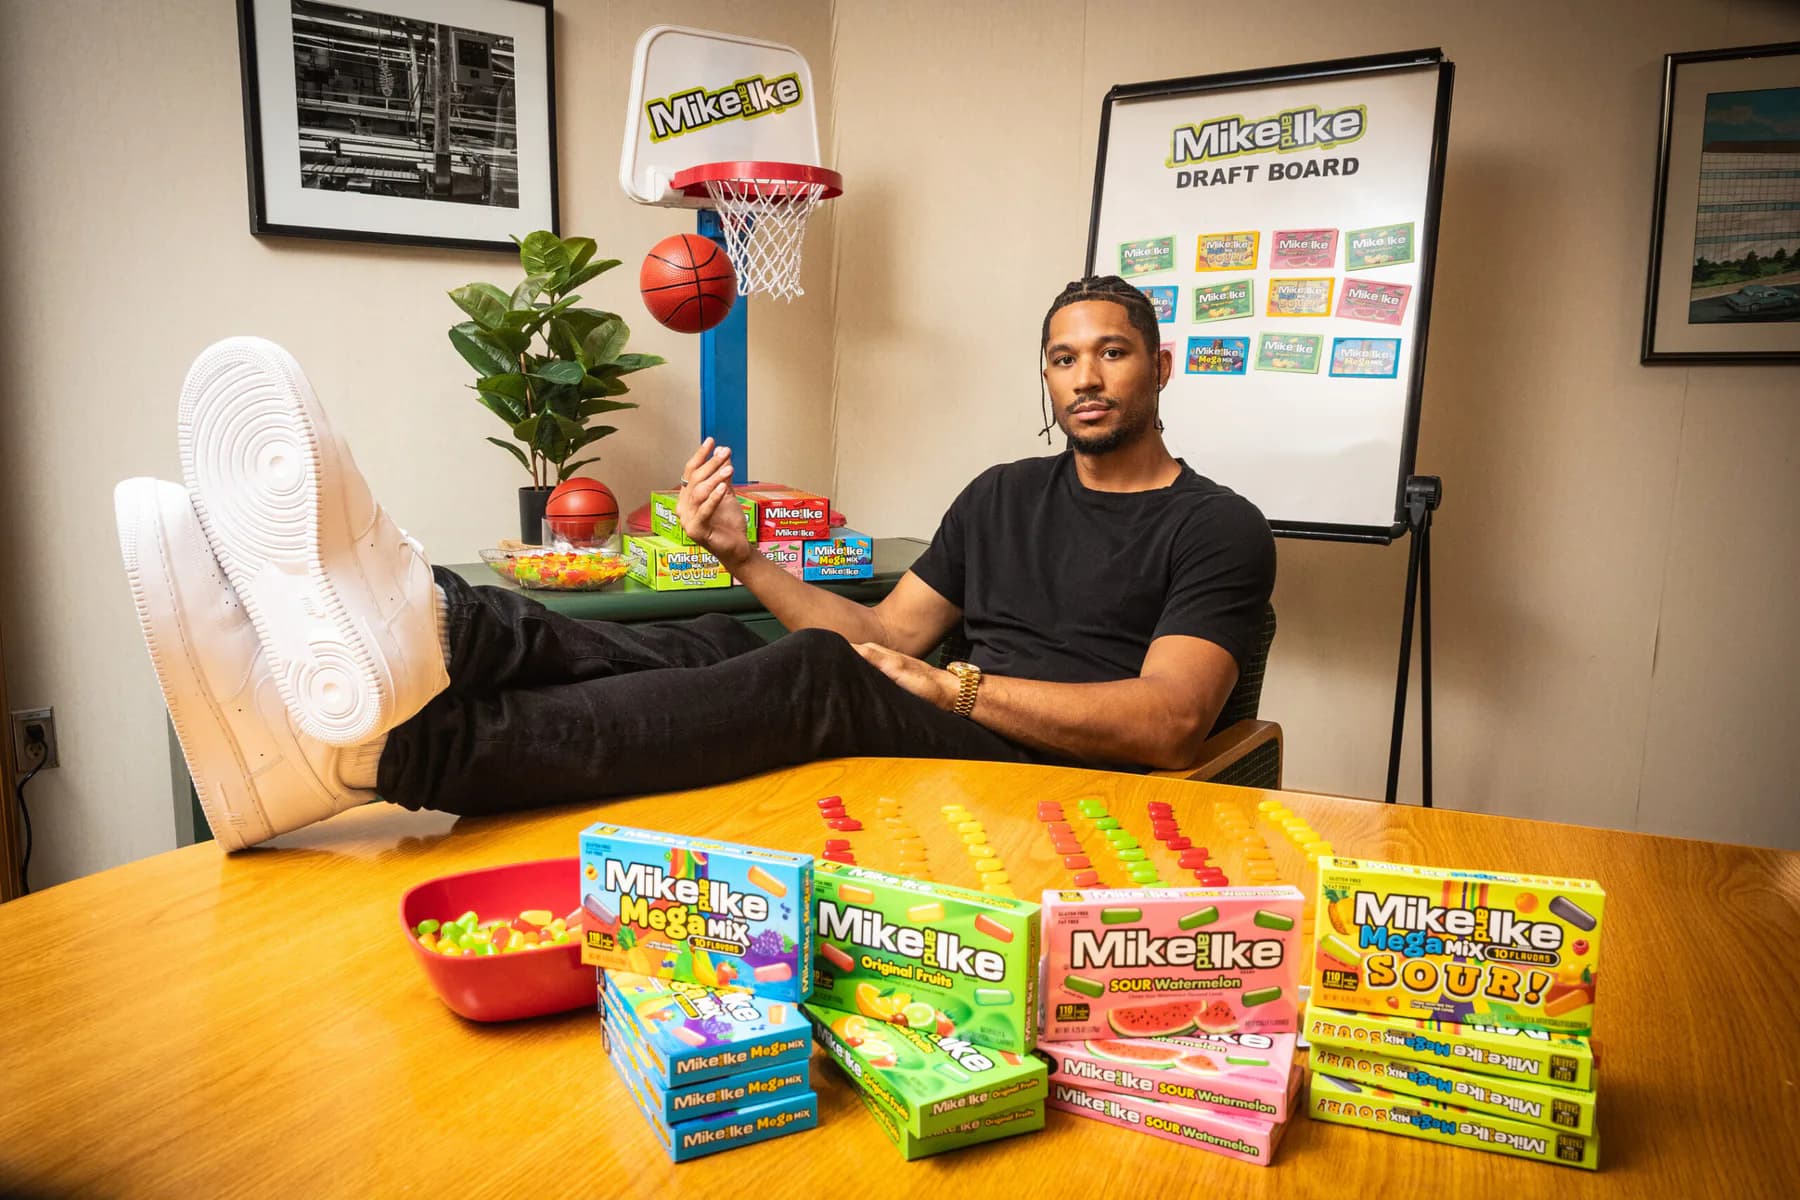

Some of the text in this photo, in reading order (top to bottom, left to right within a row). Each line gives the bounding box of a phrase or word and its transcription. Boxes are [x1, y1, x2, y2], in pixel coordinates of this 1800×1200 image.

[649, 91, 742, 137] Mike
[746, 78, 800, 112] Ike
[1174, 119, 1282, 163] Mike
[1293, 108, 1363, 145] Ike
[1176, 157, 1360, 189] DRAFT BOARD
[1124, 246, 1170, 259] Mike Ike
[1206, 240, 1230, 249] Mike
[1279, 239, 1329, 249] Mike Ike
[1353, 235, 1406, 249] Mike Ike
[1199, 292, 1226, 303] Mike
[1229, 290, 1246, 299] Ike
[1349, 288, 1378, 301] Mike
[1381, 294, 1399, 305] Ike
[1195, 345, 1239, 357] Mike Ike
[1264, 340, 1313, 354] Mike Ike
[765, 507, 823, 519] Mike Ike
[775, 529, 815, 537] Mike Ike
[667, 553, 699, 563] Mike
[777, 551, 798, 562] Ike
[814, 546, 864, 556] Mike Ike
[821, 568, 859, 576] Mike Ike
[605, 858, 700, 905] Mike
[709, 880, 769, 922] Ike
[620, 893, 706, 940] Mega
[1354, 891, 1475, 936] Mike
[1488, 908, 1563, 950] Ike
[694, 938, 705, 948] 10
[705, 940, 739, 954] FLAVORS
[818, 900, 925, 959] Mike
[935, 930, 1005, 983] Ike
[1072, 929, 1197, 969] Mike
[1211, 931, 1283, 969] Ike
[1359, 925, 1445, 958] Mega
[1494, 949, 1508, 959] 10
[1508, 951, 1551, 963] FLAVORS
[861, 955, 913, 981] Original
[916, 967, 953, 989] Fruits
[1326, 971, 1341, 981] 110
[1366, 953, 1550, 1006] SOUR!
[1110, 976, 1241, 992] SOUR Watermelon
[1059, 1005, 1073, 1014] 110
[677, 1054, 720, 1074] Mike
[722, 1051, 747, 1066] Ike
[751, 1041, 788, 1059] Mega
[816, 1023, 844, 1059] Mike
[844, 1050, 863, 1078] Ike
[1406, 1036, 1451, 1057] Mega
[1454, 1045, 1484, 1064] Ike
[1490, 1052, 1540, 1076] Mike
[674, 1090, 716, 1110] Mike
[720, 1087, 745, 1102] Ike
[748, 1076, 785, 1094] Mega
[1064, 1059, 1117, 1083] Mike
[1121, 1070, 1153, 1092] Ike
[1158, 1082, 1196, 1100] SOUR
[1197, 1090, 1277, 1115] Watermelon
[1407, 1070, 1453, 1094] Mega
[1456, 1082, 1485, 1103] Ike
[932, 1096, 966, 1116] Mike
[969, 1091, 988, 1105] Ike
[992, 1085, 1020, 1099] Original
[1490, 1093, 1541, 1118] Mike
[684, 1127, 725, 1149] Mike
[730, 1123, 753, 1137] Ike
[756, 1111, 793, 1130] Mega
[1056, 1085, 1106, 1112] Mike
[1110, 1101, 1141, 1125] Ike
[1145, 1116, 1181, 1135] SOUR
[1182, 1125, 1260, 1156] Watermelon
[1411, 1113, 1457, 1136] Mega
[1460, 1122, 1489, 1142] Ike
[1495, 1131, 1546, 1154] Mike
